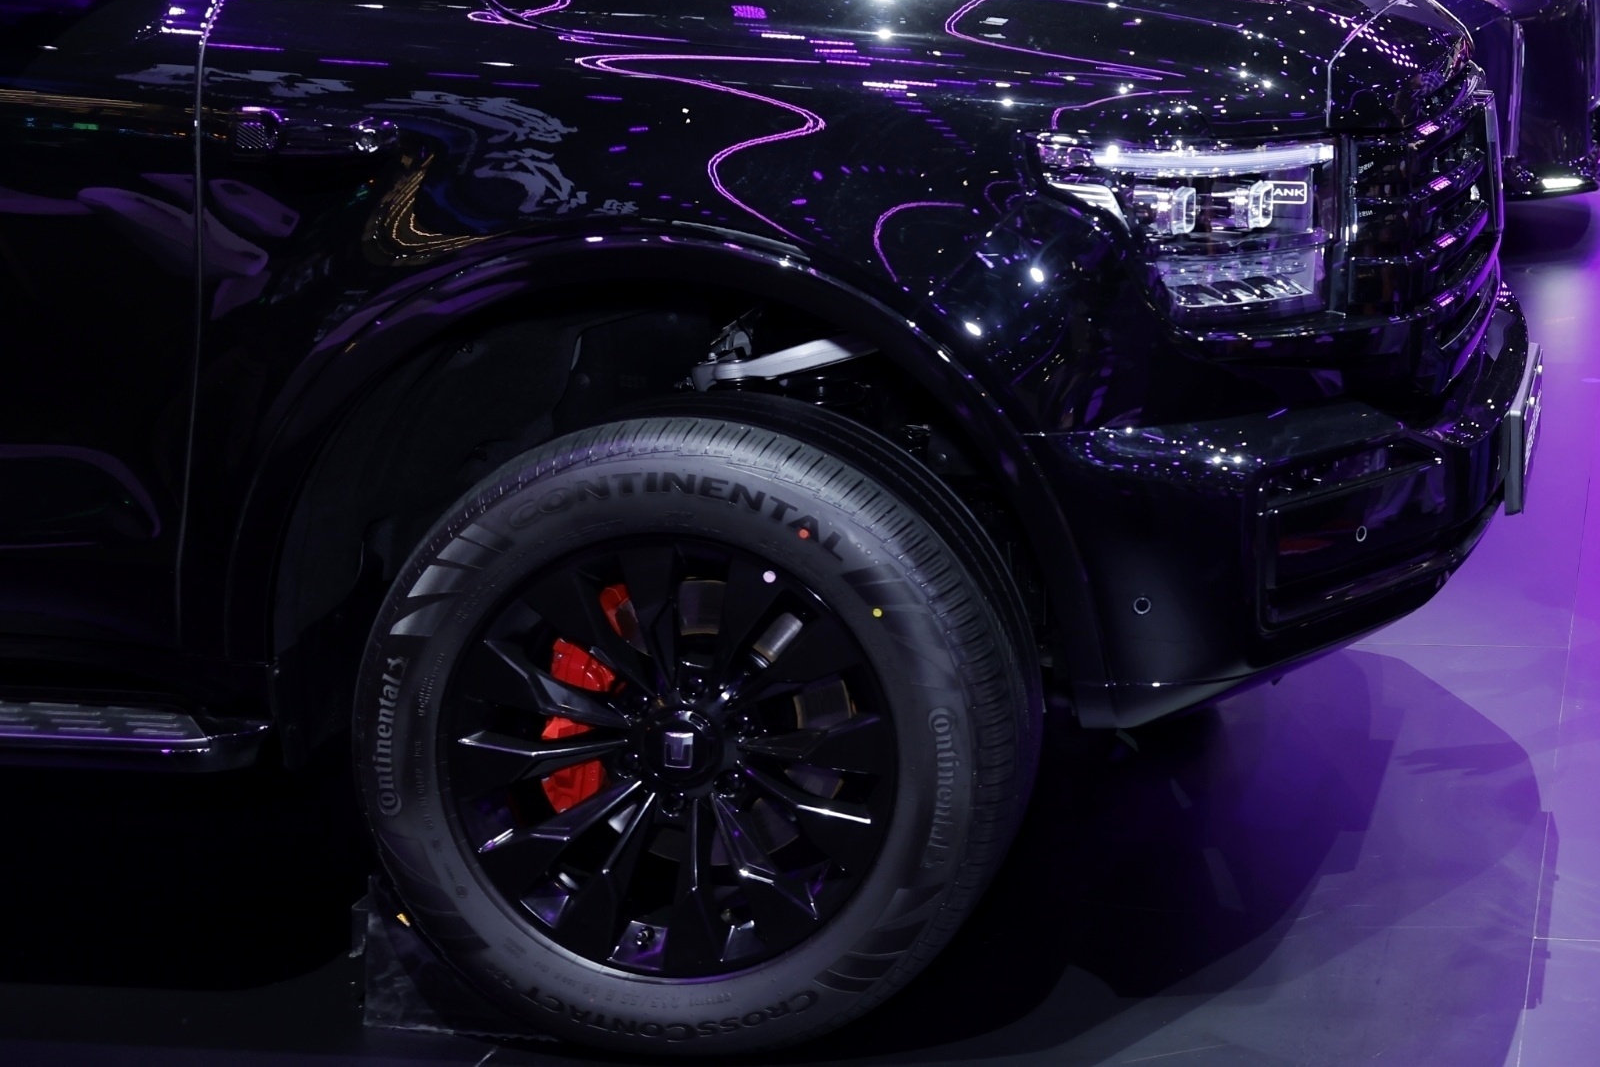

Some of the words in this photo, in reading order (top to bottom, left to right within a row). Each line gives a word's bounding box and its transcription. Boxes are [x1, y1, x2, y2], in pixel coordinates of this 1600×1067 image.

[1273, 187, 1304, 197] ANK
[508, 471, 844, 562] CONTINENTAL
[372, 671, 402, 817] Continental
[927, 707, 958, 849] Continental
